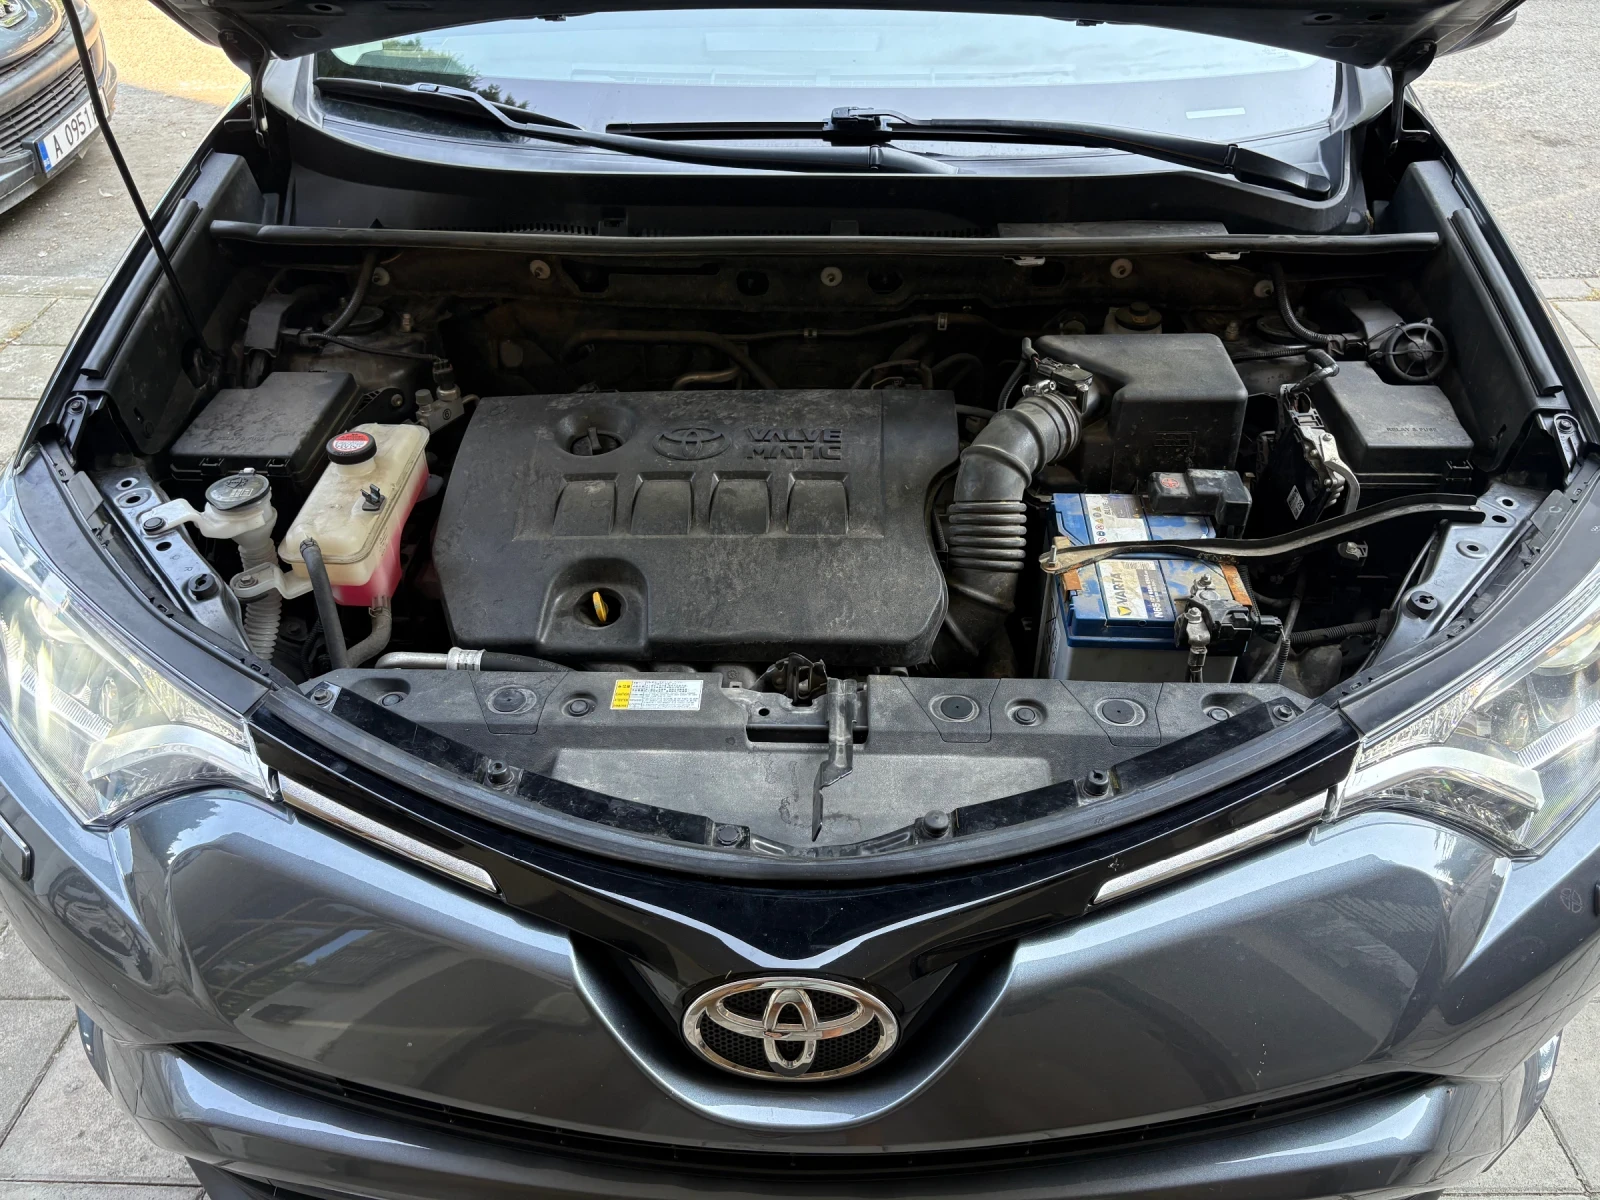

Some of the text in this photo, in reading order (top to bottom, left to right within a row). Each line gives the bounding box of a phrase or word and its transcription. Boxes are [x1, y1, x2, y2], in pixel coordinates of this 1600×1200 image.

[53, 134, 63, 159] A
[65, 106, 92, 146] 0951
[745, 428, 841, 443] VALVE
[746, 446, 841, 460] MATIC
[1111, 573, 1128, 604] VARTA
